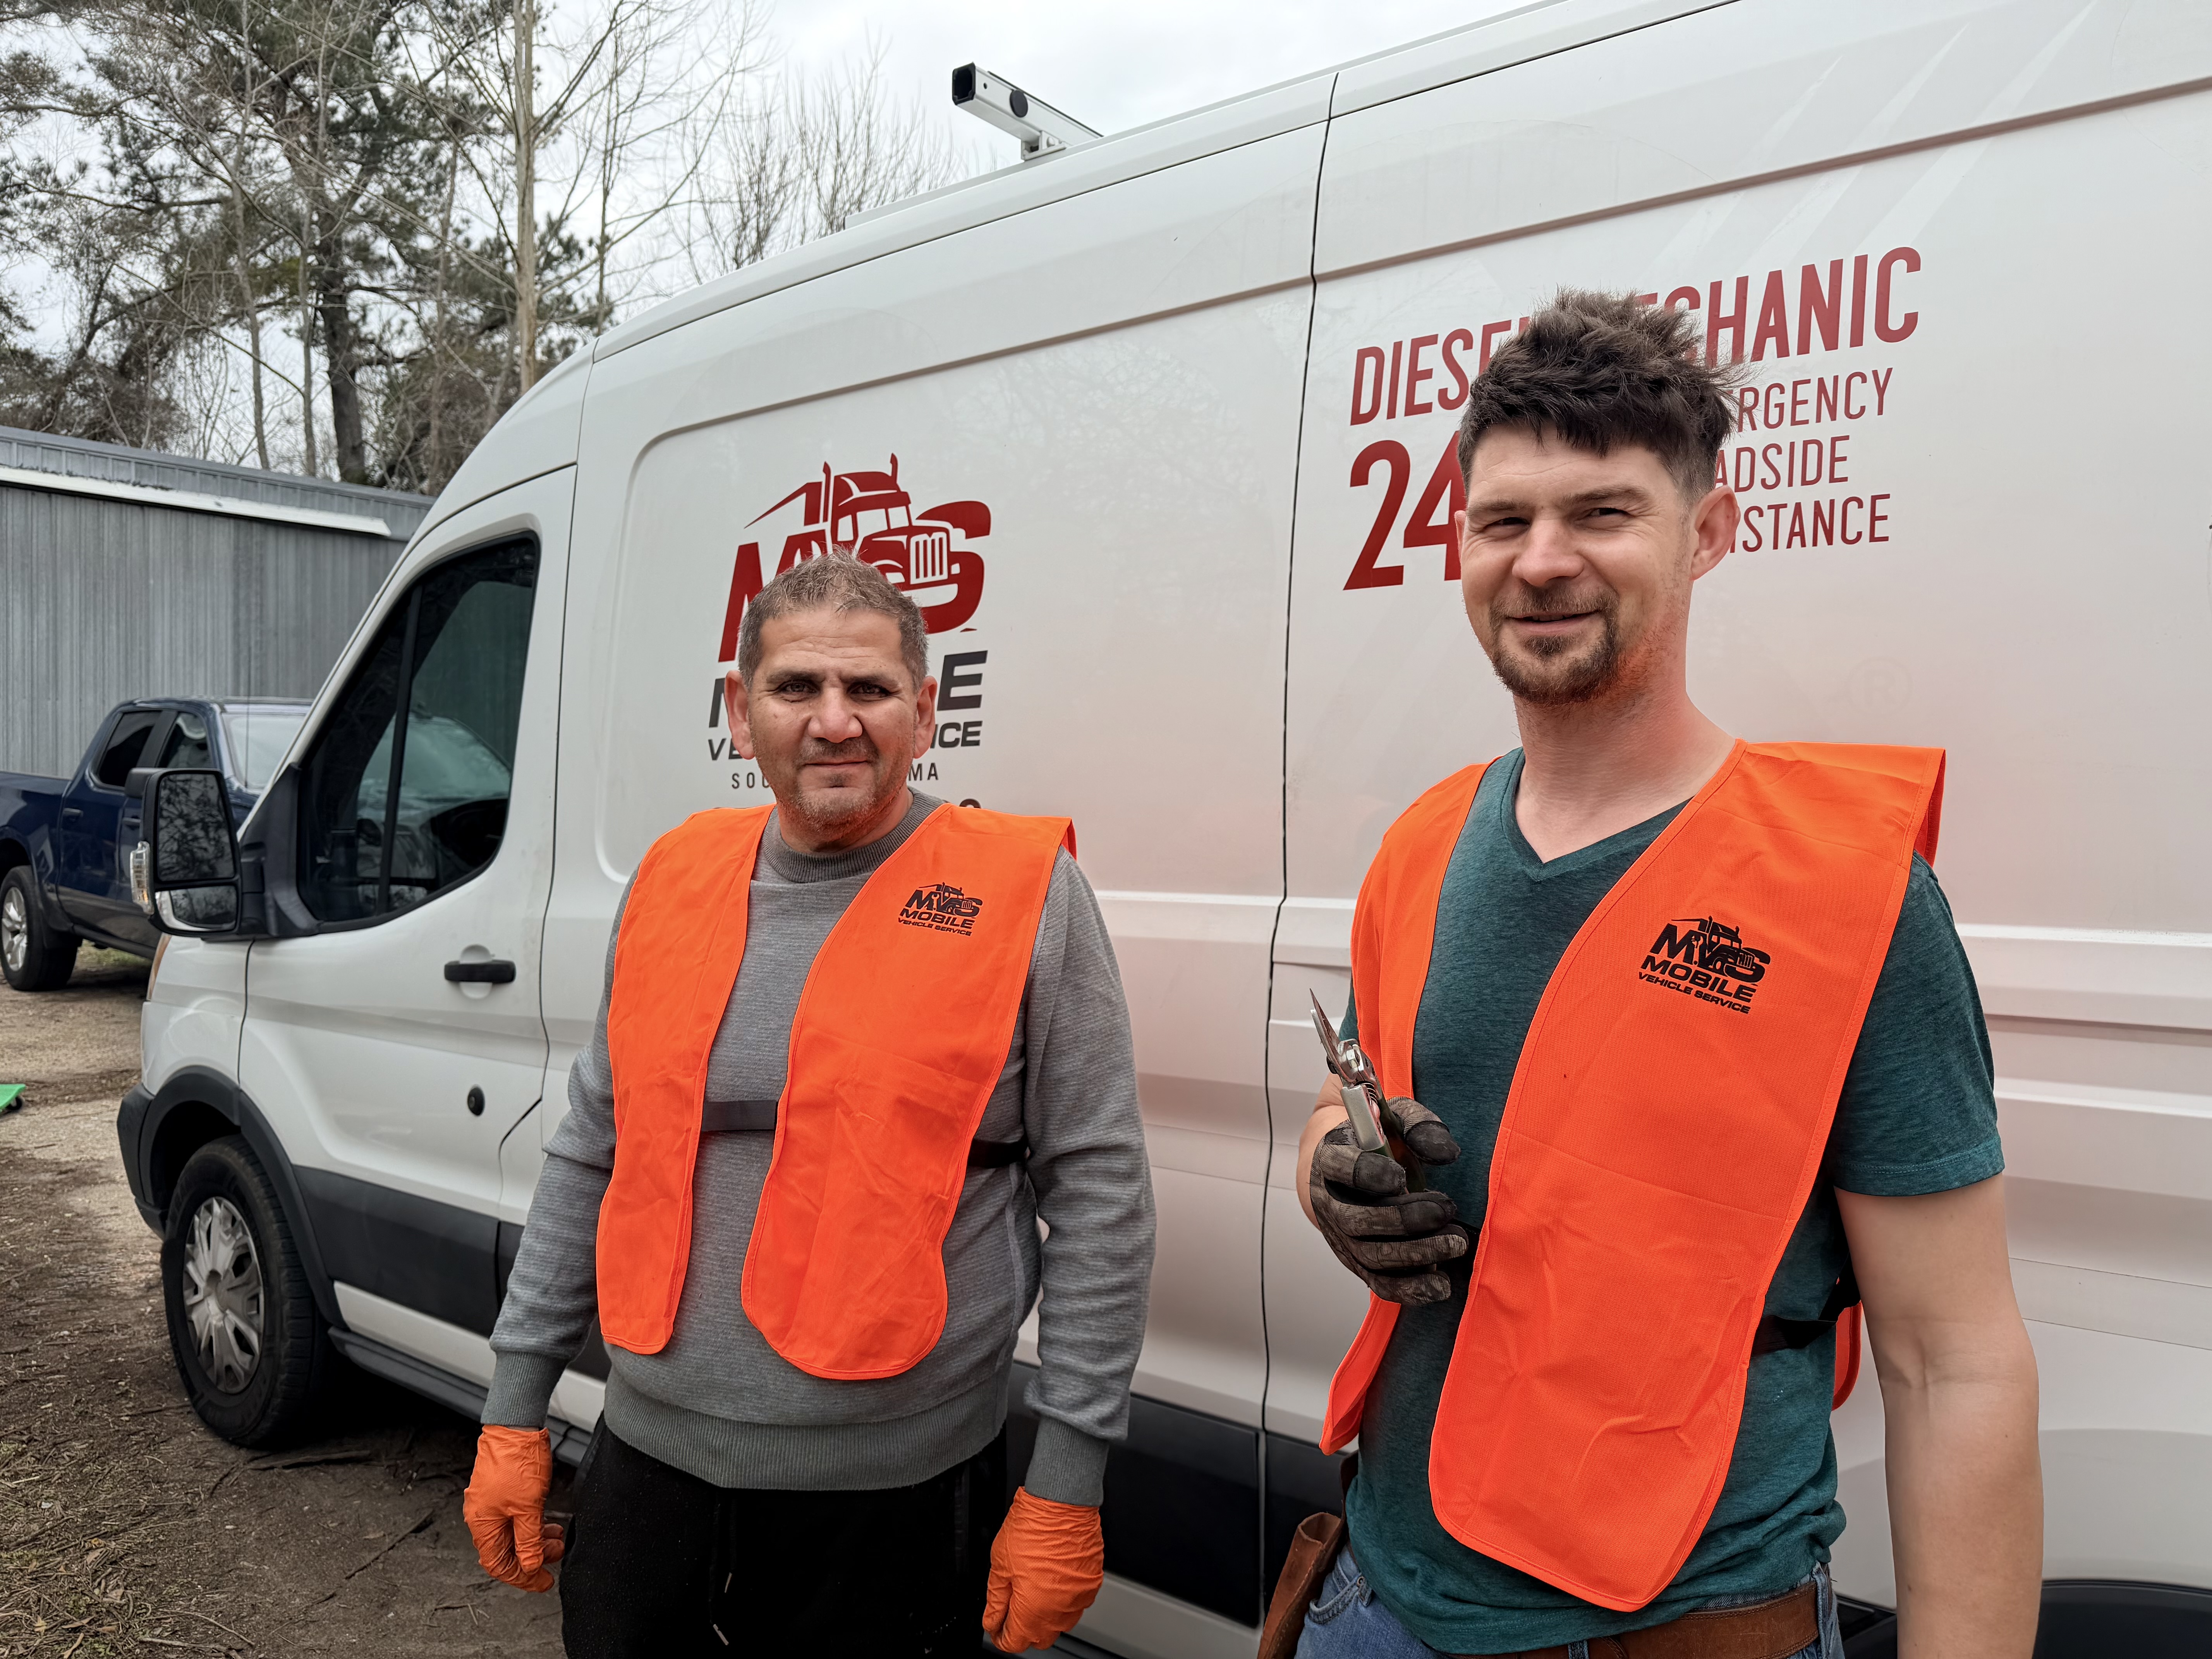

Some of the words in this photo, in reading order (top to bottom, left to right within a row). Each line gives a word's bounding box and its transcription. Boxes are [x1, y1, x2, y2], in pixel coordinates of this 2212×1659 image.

[1350, 316, 1530, 426] DIES
[1719, 368, 1893, 433] RGENCY
[1715, 435, 1850, 493] ADSIDE
[898, 917, 934, 929] VEHICLE
[934, 925, 972, 936] SERVICE
[899, 908, 975, 929] MOBILE
[1638, 972, 1693, 994] VEHICLE
[1694, 989, 1751, 1014] SERVICE
[1640, 955, 1757, 1003] MOBILE
